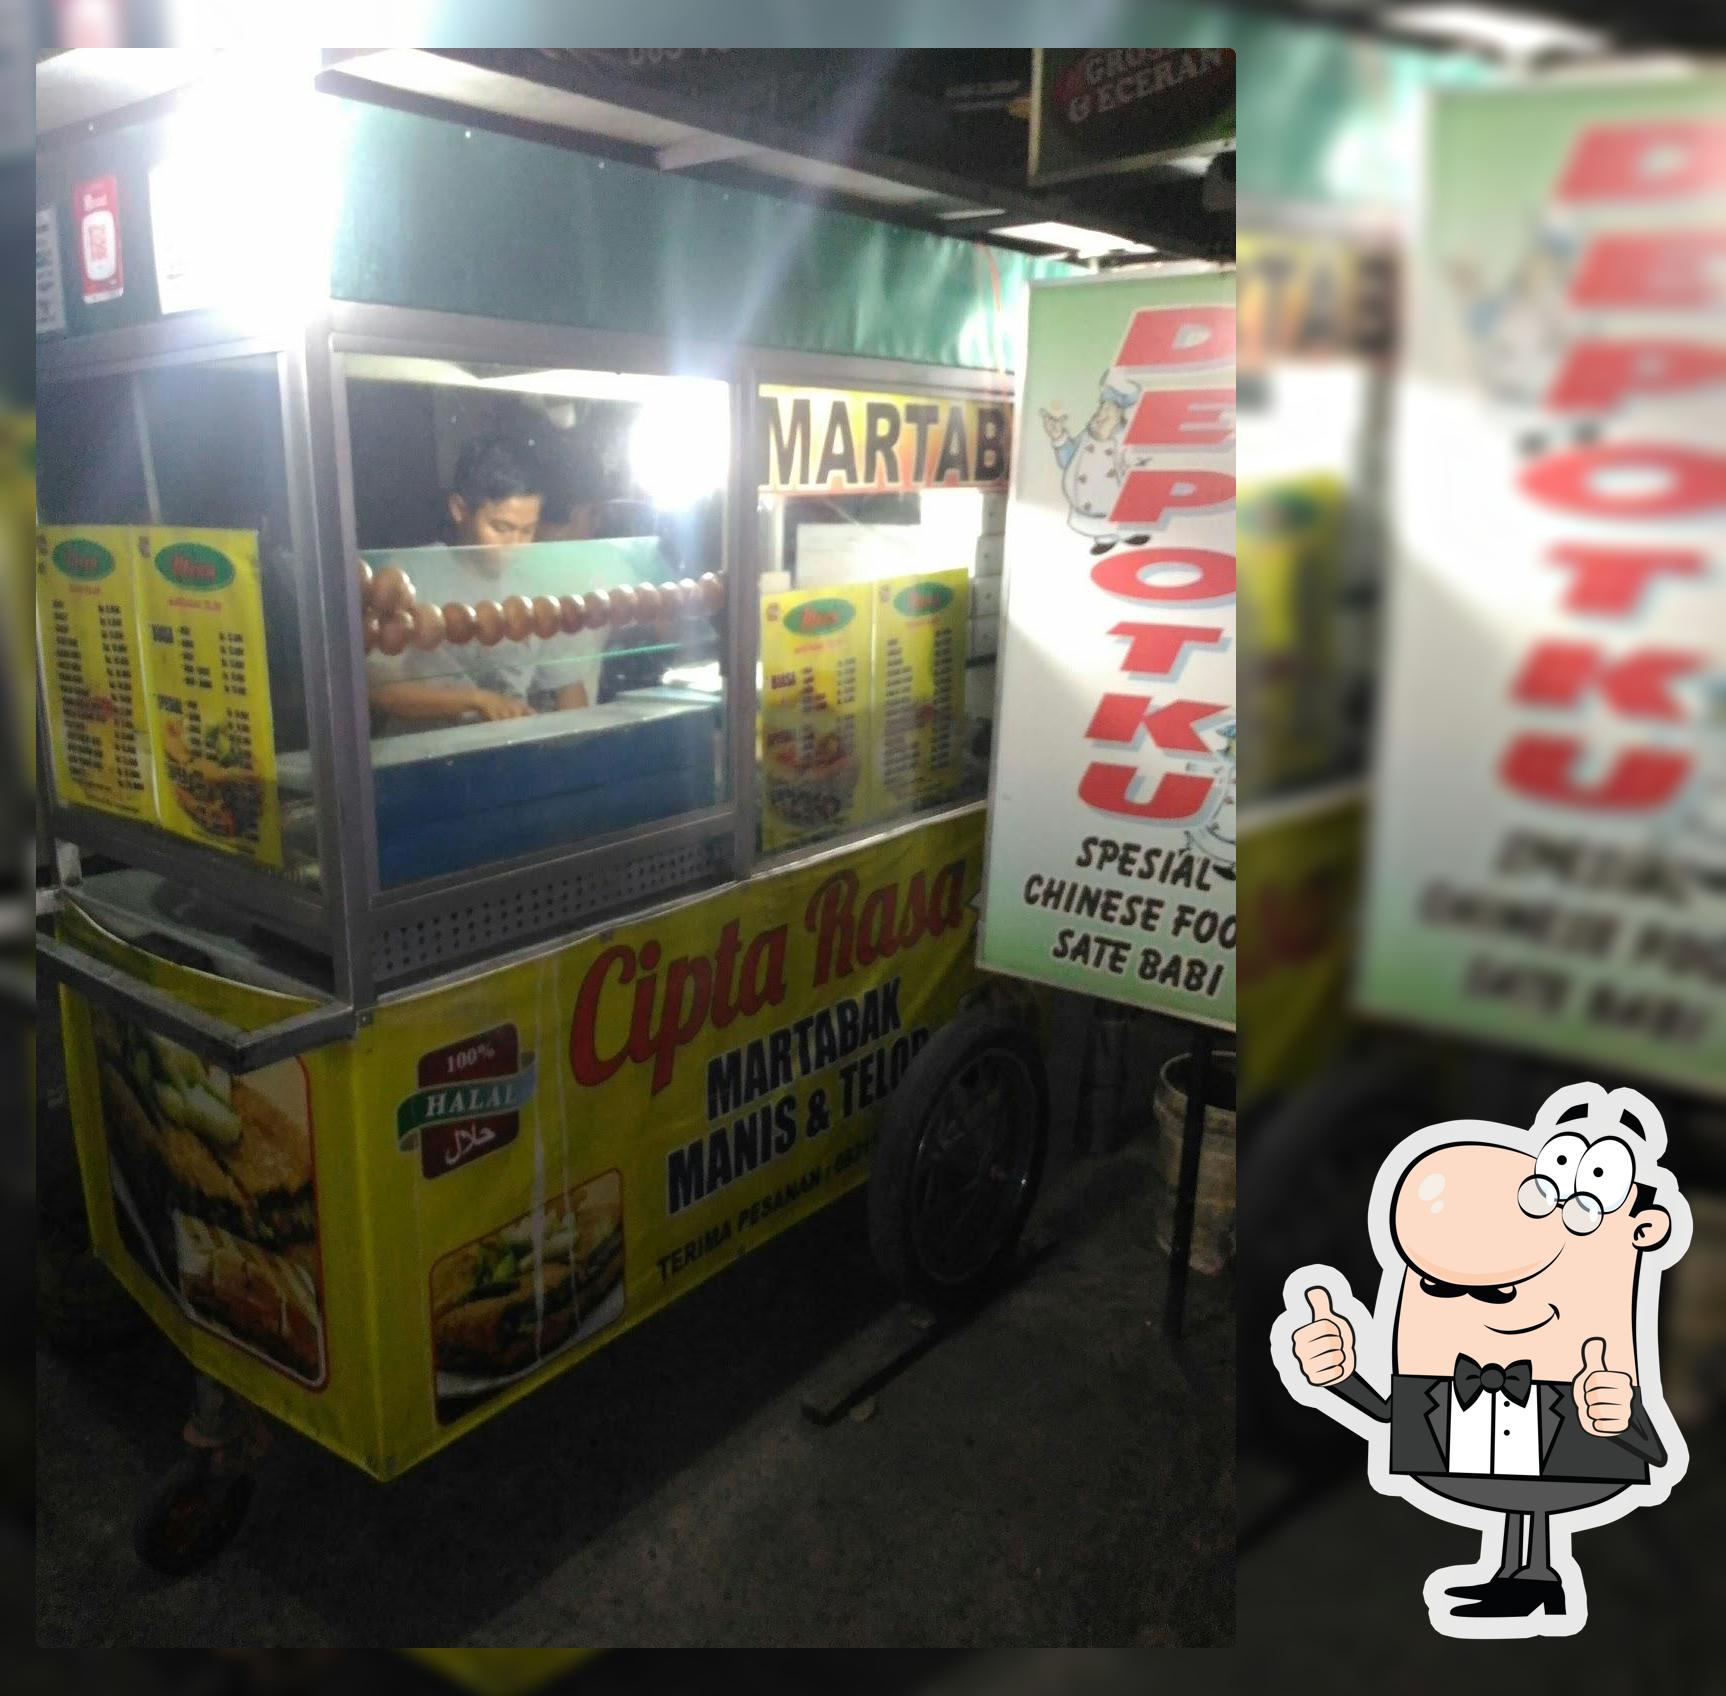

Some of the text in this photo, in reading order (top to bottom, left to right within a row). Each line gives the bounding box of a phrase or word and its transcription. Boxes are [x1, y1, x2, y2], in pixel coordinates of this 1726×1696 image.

[1097, 49, 1223, 114] ECERAN
[1075, 835, 1212, 892] SPESIAL
[1023, 873, 1165, 933] CHINESE
[569, 858, 967, 1096] Cipta Rasa
[1052, 928, 1225, 997] SATE BABI
[447, 1041, 496, 1073] 100%
[707, 975, 901, 1121] MARTABAK
[424, 1084, 517, 1118] HALAL
[445, 1120, 497, 1165] حلال
[667, 1093, 797, 1215] MANIS
[805, 1087, 831, 1138] &
[655, 1165, 822, 1285] TERIMA PESANAN
